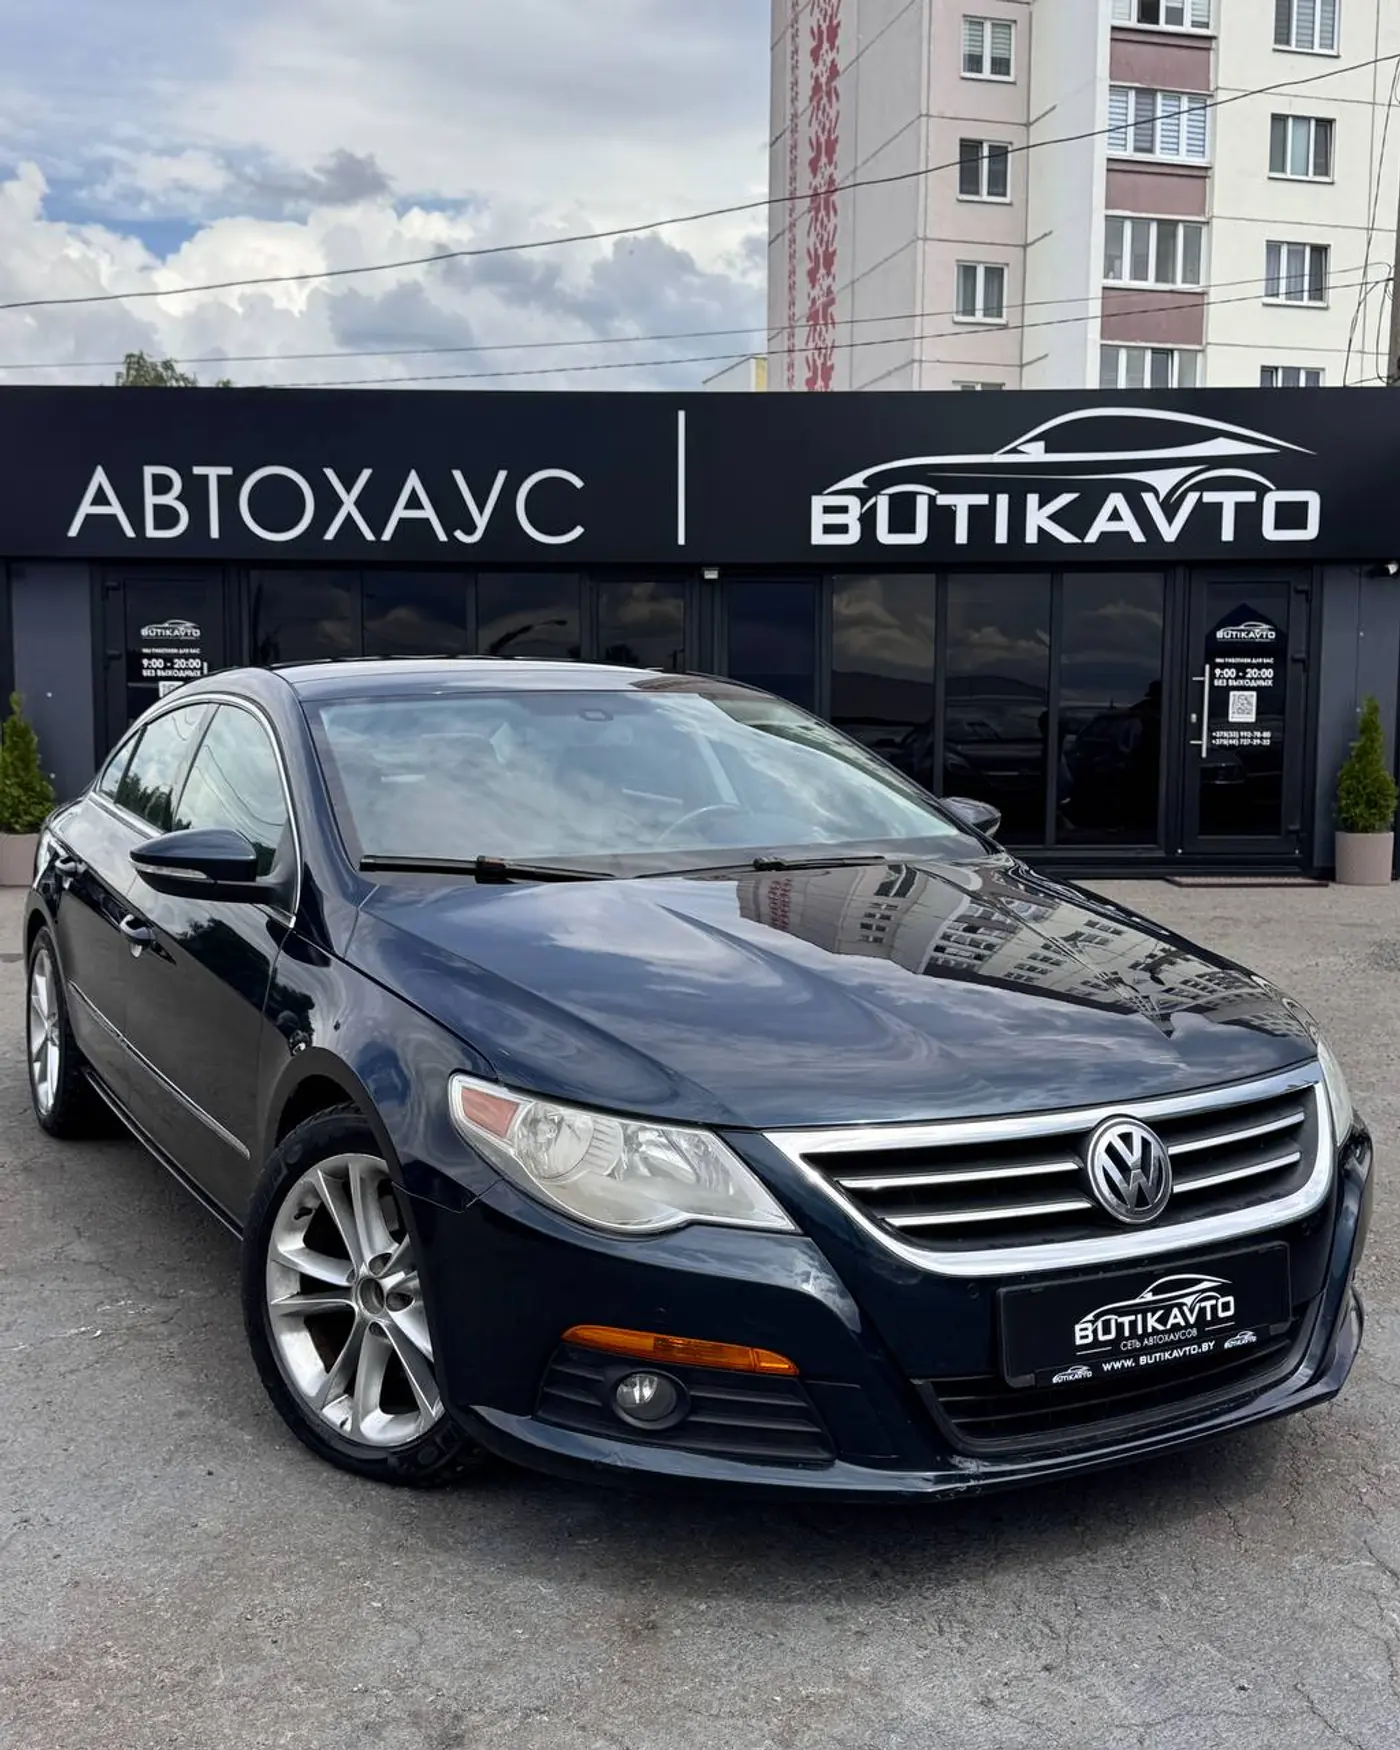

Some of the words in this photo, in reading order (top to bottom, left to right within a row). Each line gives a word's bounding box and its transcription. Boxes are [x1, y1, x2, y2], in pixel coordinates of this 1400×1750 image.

[67, 465, 585, 545] АВТОХАУС
[810, 489, 1321, 545] BUTIKAVTO
[140, 628, 201, 637] BUTIKAVTO
[1215, 630, 1276, 639] BUTIKAVTO
[142, 658, 165, 669] 9:00
[173, 658, 201, 669] 20:00
[142, 669, 156, 677] БЕЗ
[157, 669, 201, 677] ВЫХОДНЫХ
[1214, 668, 1236, 678] 9:00
[1245, 668, 1274, 678] 20:00
[1214, 679, 1227, 687] БЕЗ
[1228, 679, 1274, 687] ВЫХОДНЫХ
[1074, 1295, 1235, 1346] BUTIKAVTO
[1120, 1339, 1141, 1351] СЕТЬ
[1143, 1328, 1198, 1347] АВТОХАУСОВ
[1102, 1357, 1135, 1372] WWW.
[1139, 1340, 1216, 1366] BUTIKAVTO.BY
[1052, 1370, 1093, 1383] BUTIKAVTO
